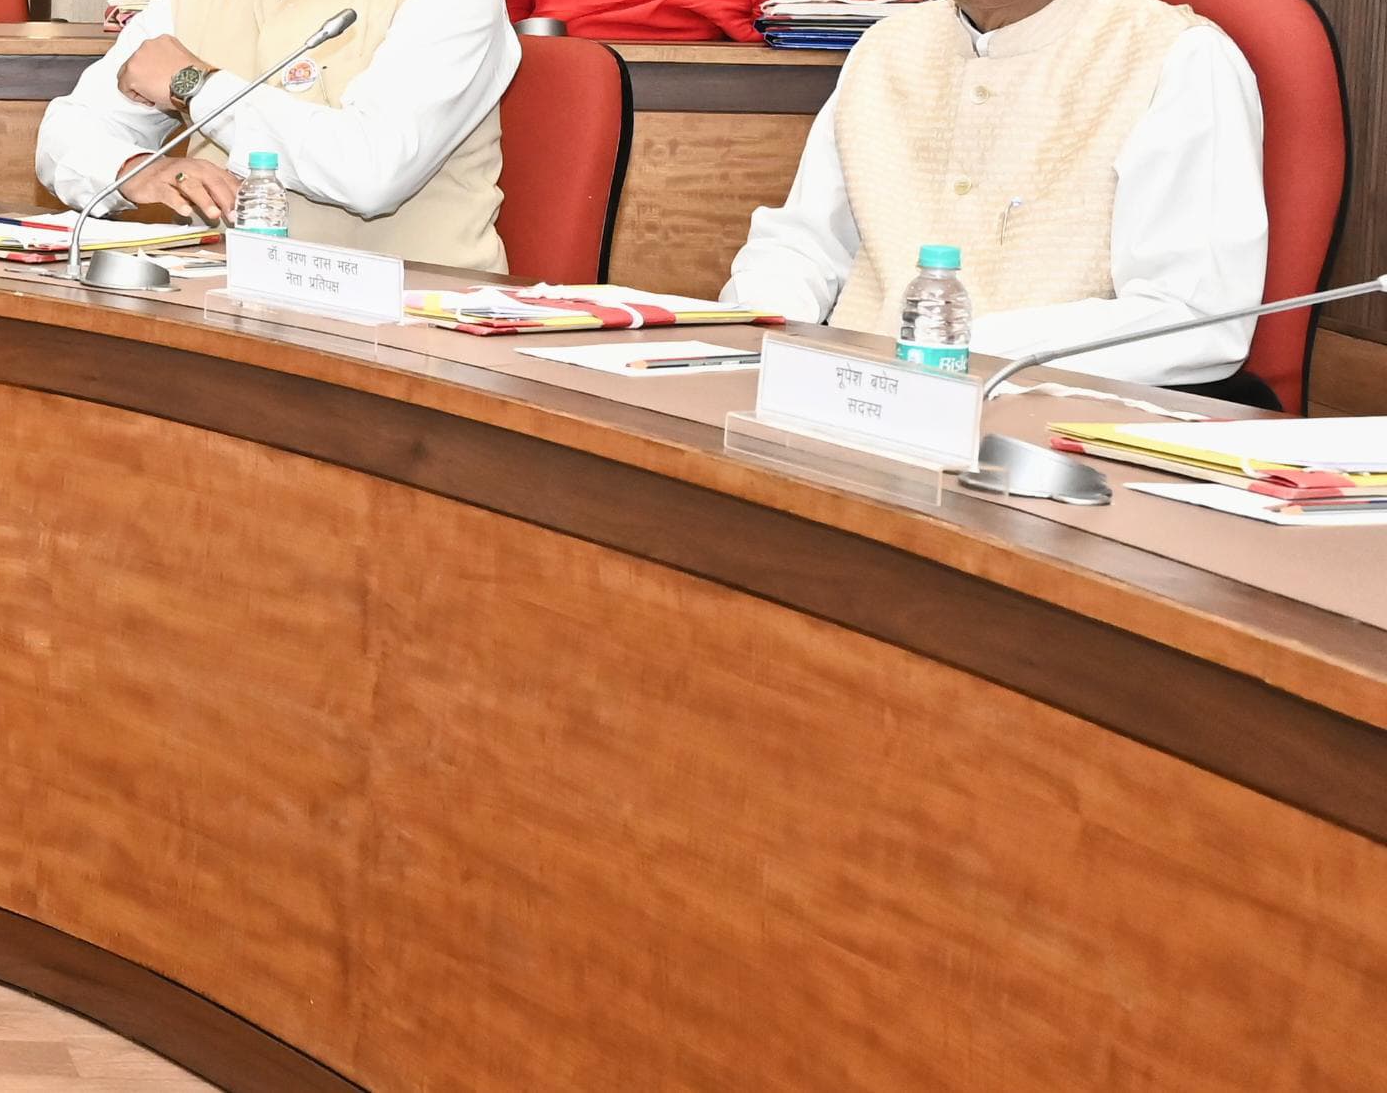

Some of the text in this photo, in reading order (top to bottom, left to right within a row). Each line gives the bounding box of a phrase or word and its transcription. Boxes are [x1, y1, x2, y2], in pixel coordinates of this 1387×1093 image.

[285, 250, 307, 267] चरण
[312, 256, 332, 272] दास
[337, 258, 359, 276] महंत
[285, 267, 340, 295] नेता प्रतिपक्ष
[835, 362, 900, 395] भूपेश बघेल
[847, 397, 883, 419] सदस्य
